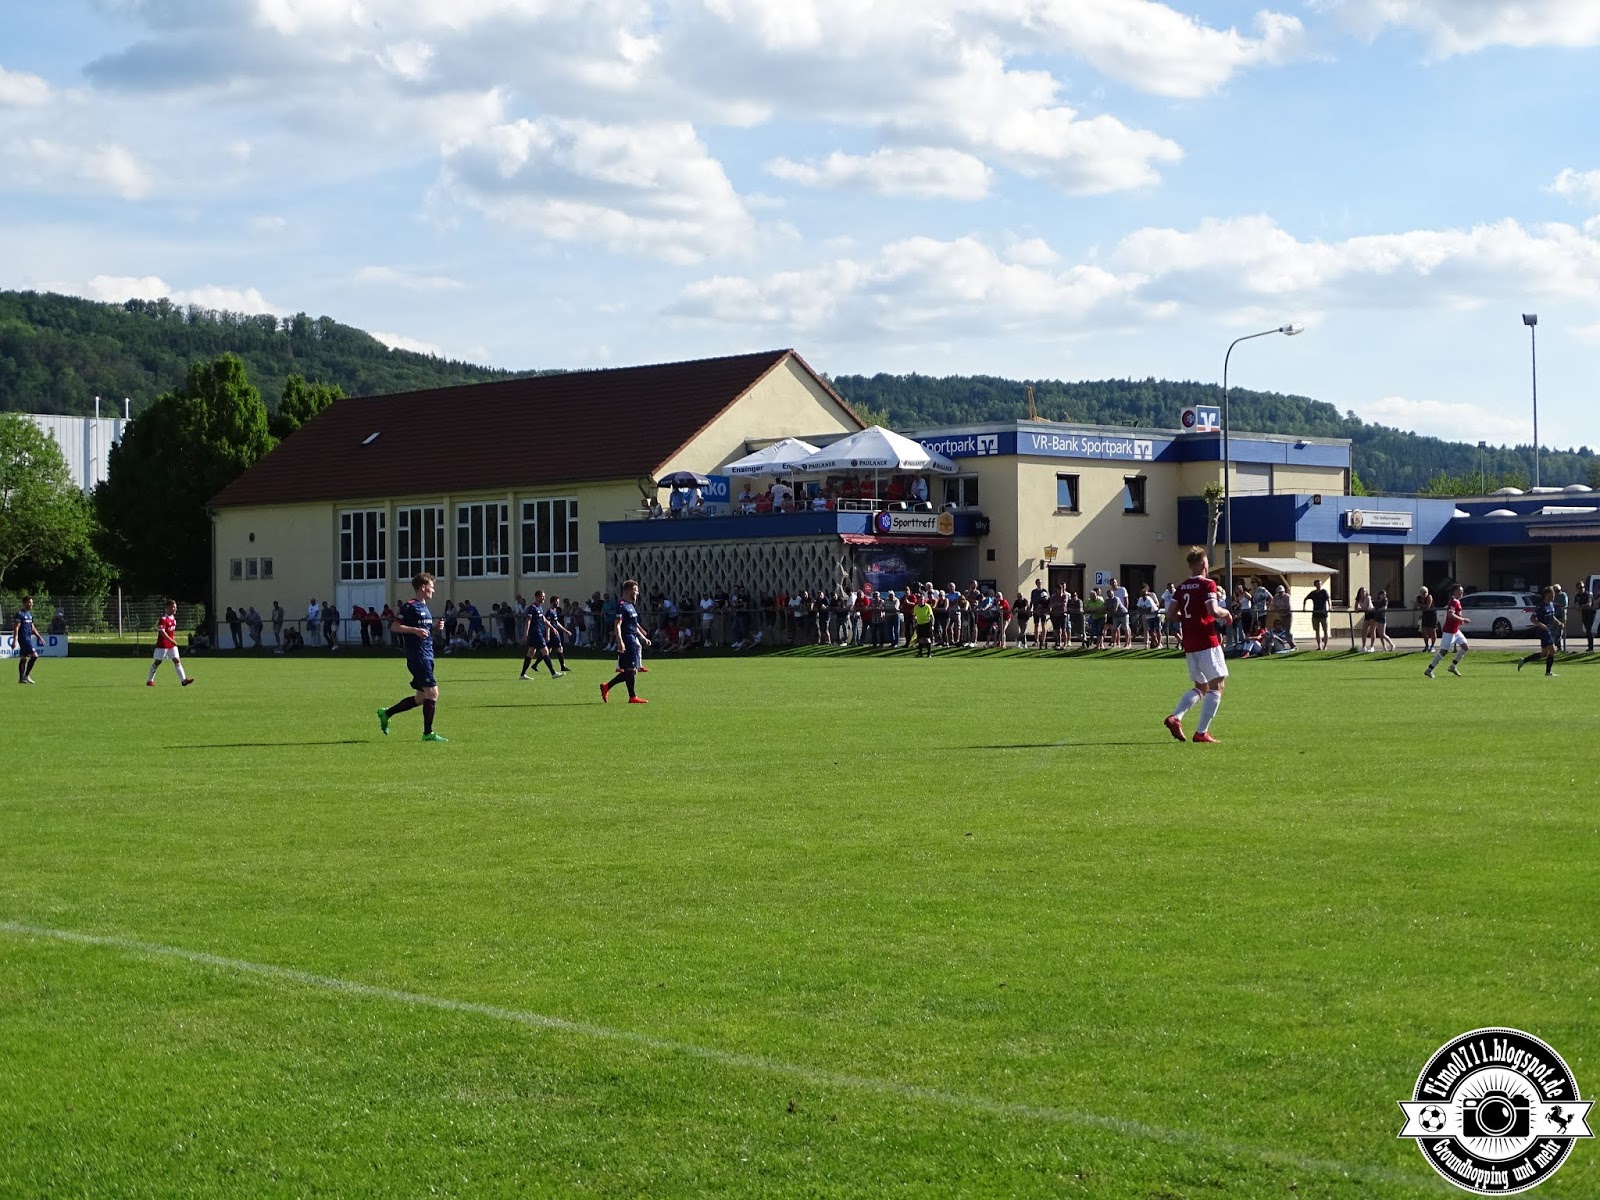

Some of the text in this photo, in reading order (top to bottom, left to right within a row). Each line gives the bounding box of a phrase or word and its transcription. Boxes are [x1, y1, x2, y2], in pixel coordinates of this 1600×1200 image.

[1031, 434, 1133, 457] VR-Bank Sportpark
[731, 465, 764, 473] Ensinger
[808, 461, 836, 469] PAULANER
[701, 482, 727, 496] AKO
[892, 517, 936, 530] Sporttreff
[975, 520, 988, 530] sky
[1183, 593, 1191, 619] 2
